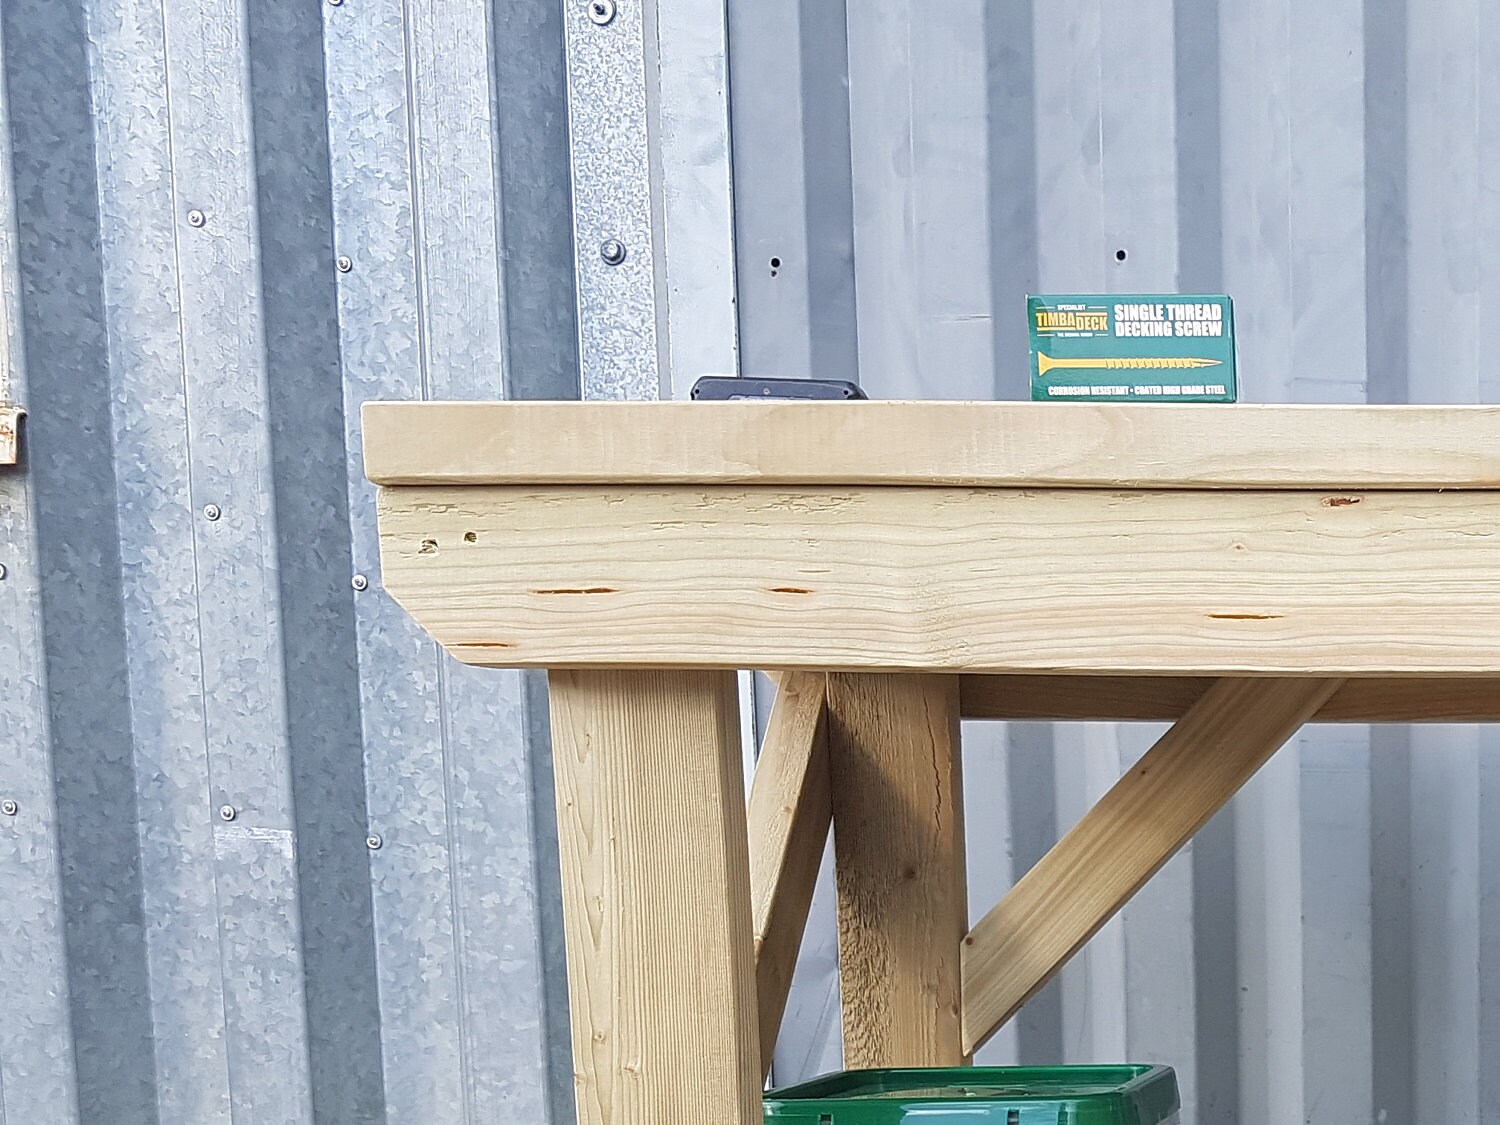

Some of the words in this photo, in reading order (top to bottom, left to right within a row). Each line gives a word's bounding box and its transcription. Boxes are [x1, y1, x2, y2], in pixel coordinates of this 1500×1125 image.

[1114, 304, 1165, 321] SINGLE
[1166, 304, 1222, 321] THREAD
[1036, 312, 1108, 331] TIMBADECK
[1115, 321, 1173, 337] DECKING
[1174, 321, 1223, 337] SCREW
